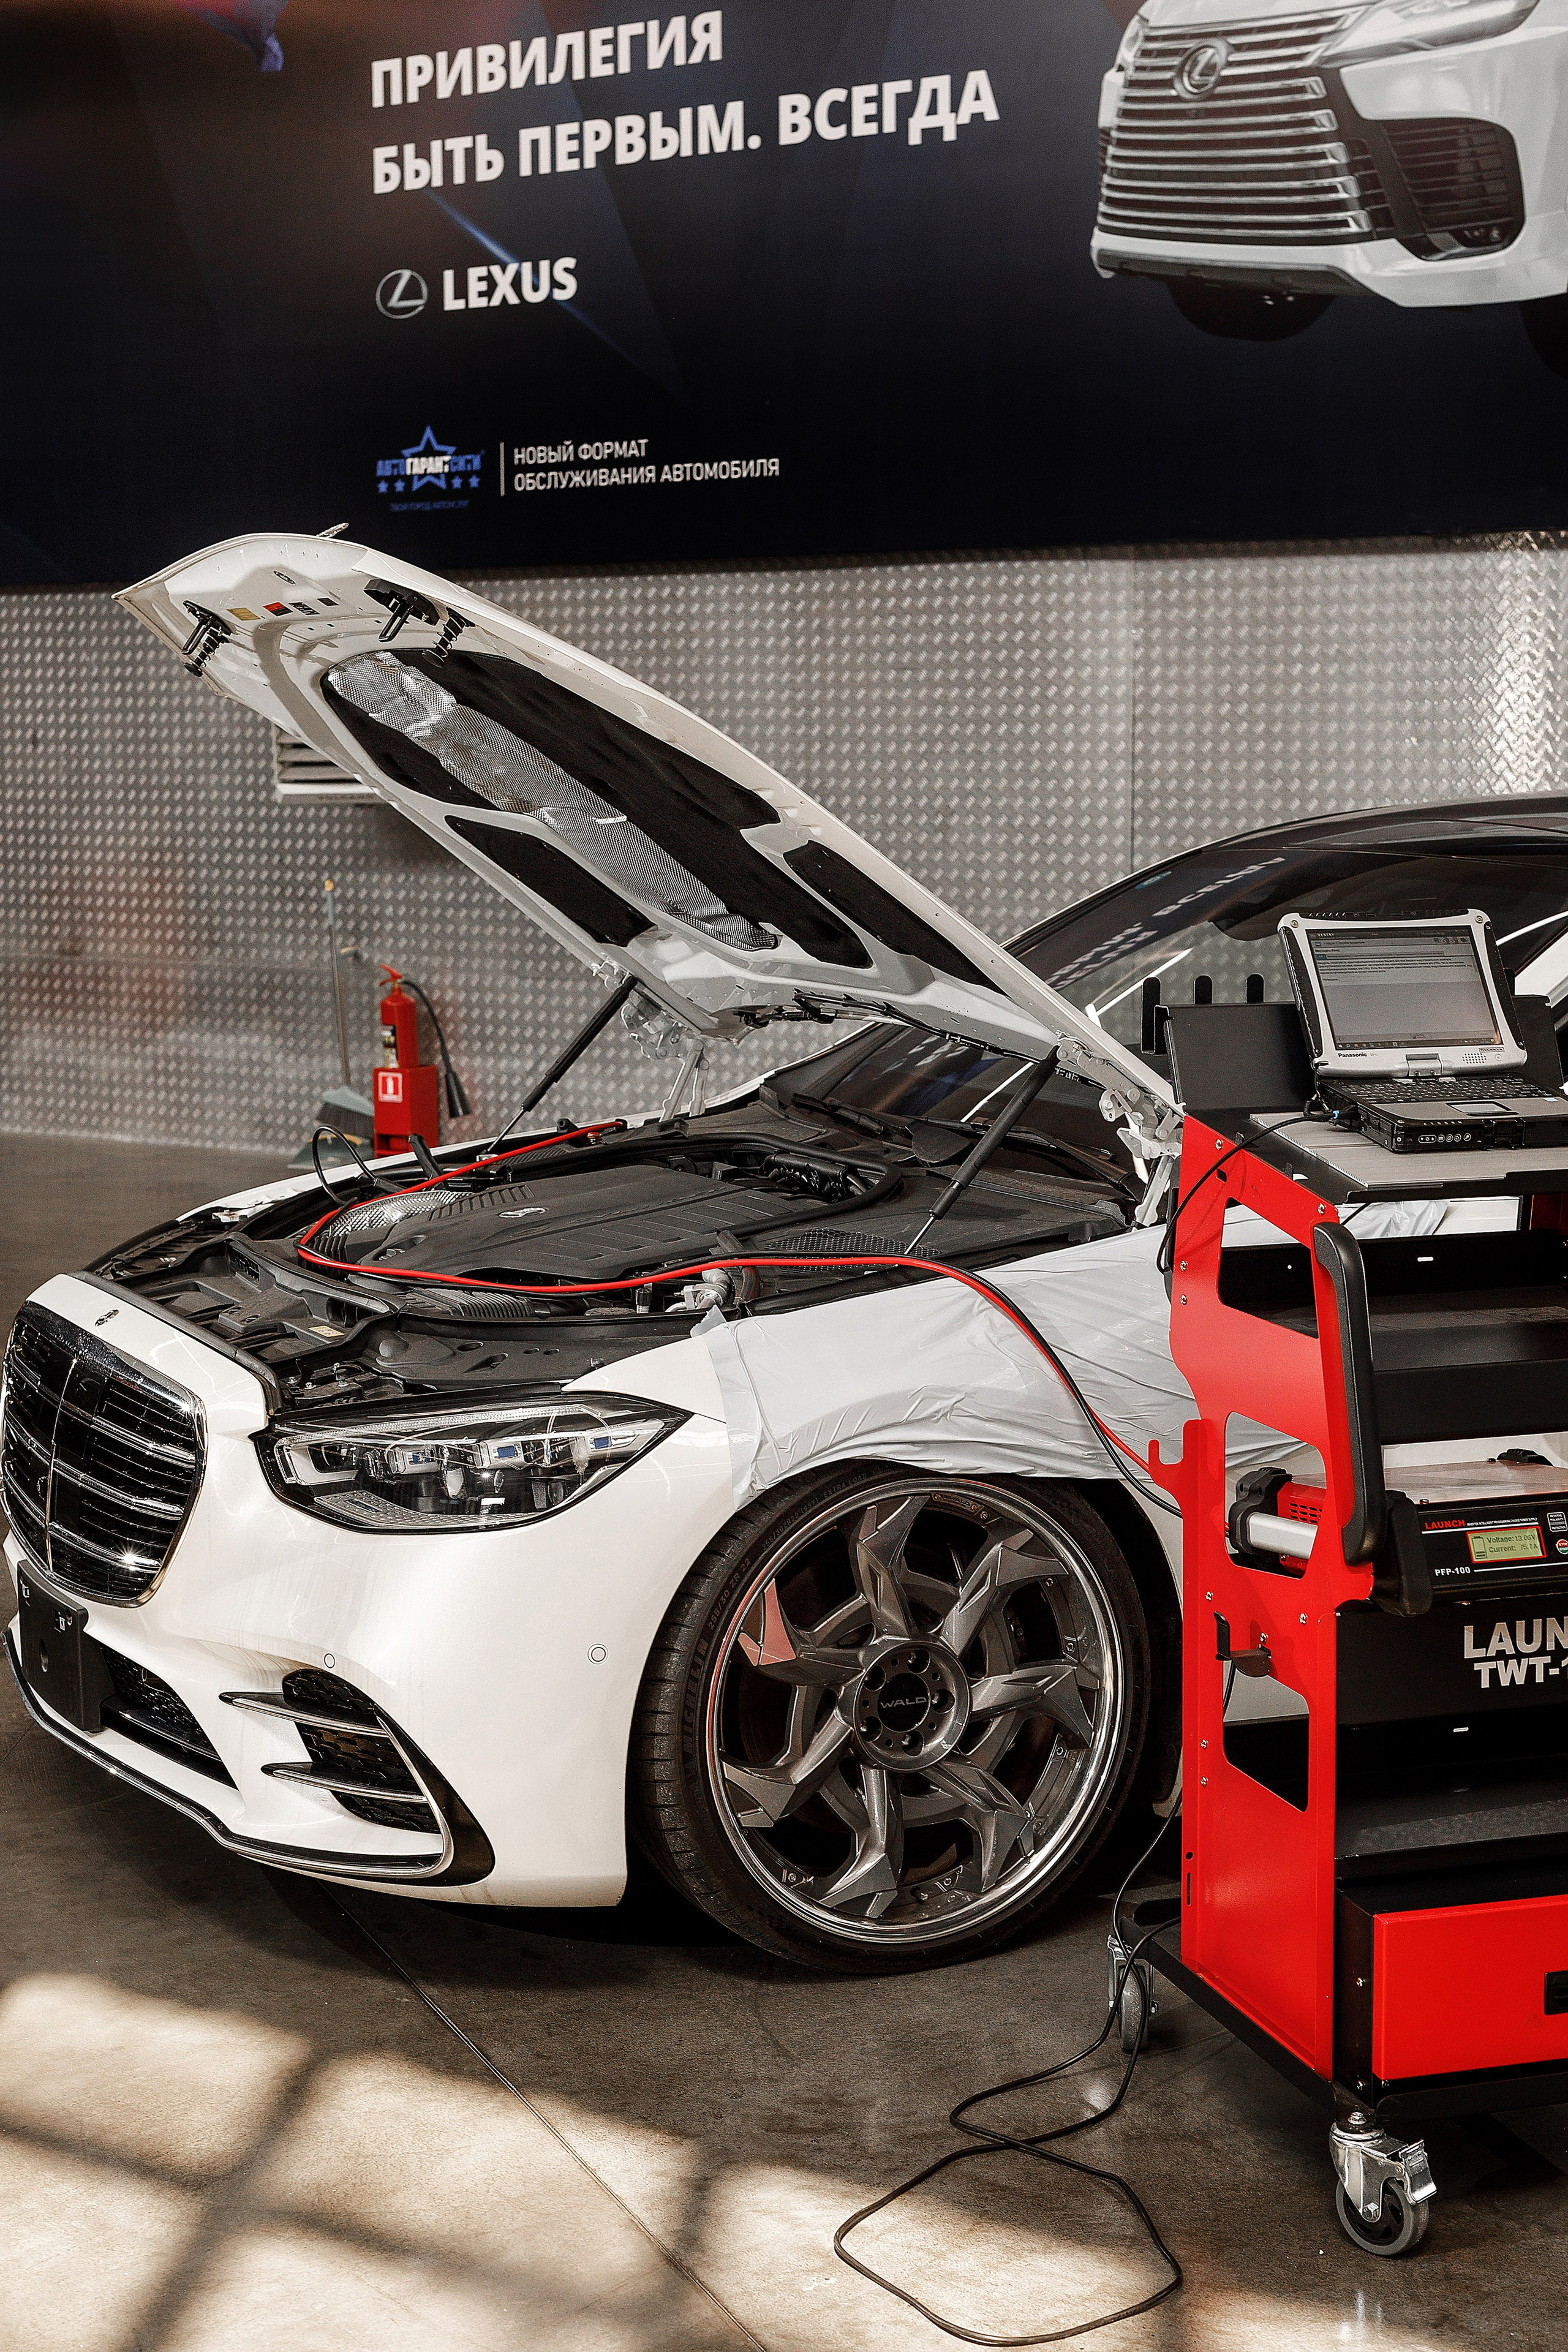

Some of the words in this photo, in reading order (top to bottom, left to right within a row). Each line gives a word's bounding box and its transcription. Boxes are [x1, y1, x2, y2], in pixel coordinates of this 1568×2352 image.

[371, 10, 722, 108] ПРИВИЛЕГИЯ
[373, 134, 504, 194] БЫТЬ
[519, 101, 761, 177] ПЕРВЫМ.
[778, 69, 1000, 146] ВСЕГДА
[443, 257, 578, 311] LEXUS
[514, 440, 574, 464] НОВЫЙ
[578, 439, 648, 460] ФОРМАТ
[514, 466, 656, 491] ОБСЛУЖИВАНИЯ
[660, 458, 780, 482] АВТОМОБИЛЯ
[1425, 1519, 1466, 1530] LAUNCH
[1487, 1535, 1514, 1544] Voltage:
[1488, 1545, 1517, 1553] Current:
[1434, 1566, 1471, 1577] PFP-100
[682, 1637, 710, 1754] MICHELIN
[880, 1696, 927, 1709] WALD
